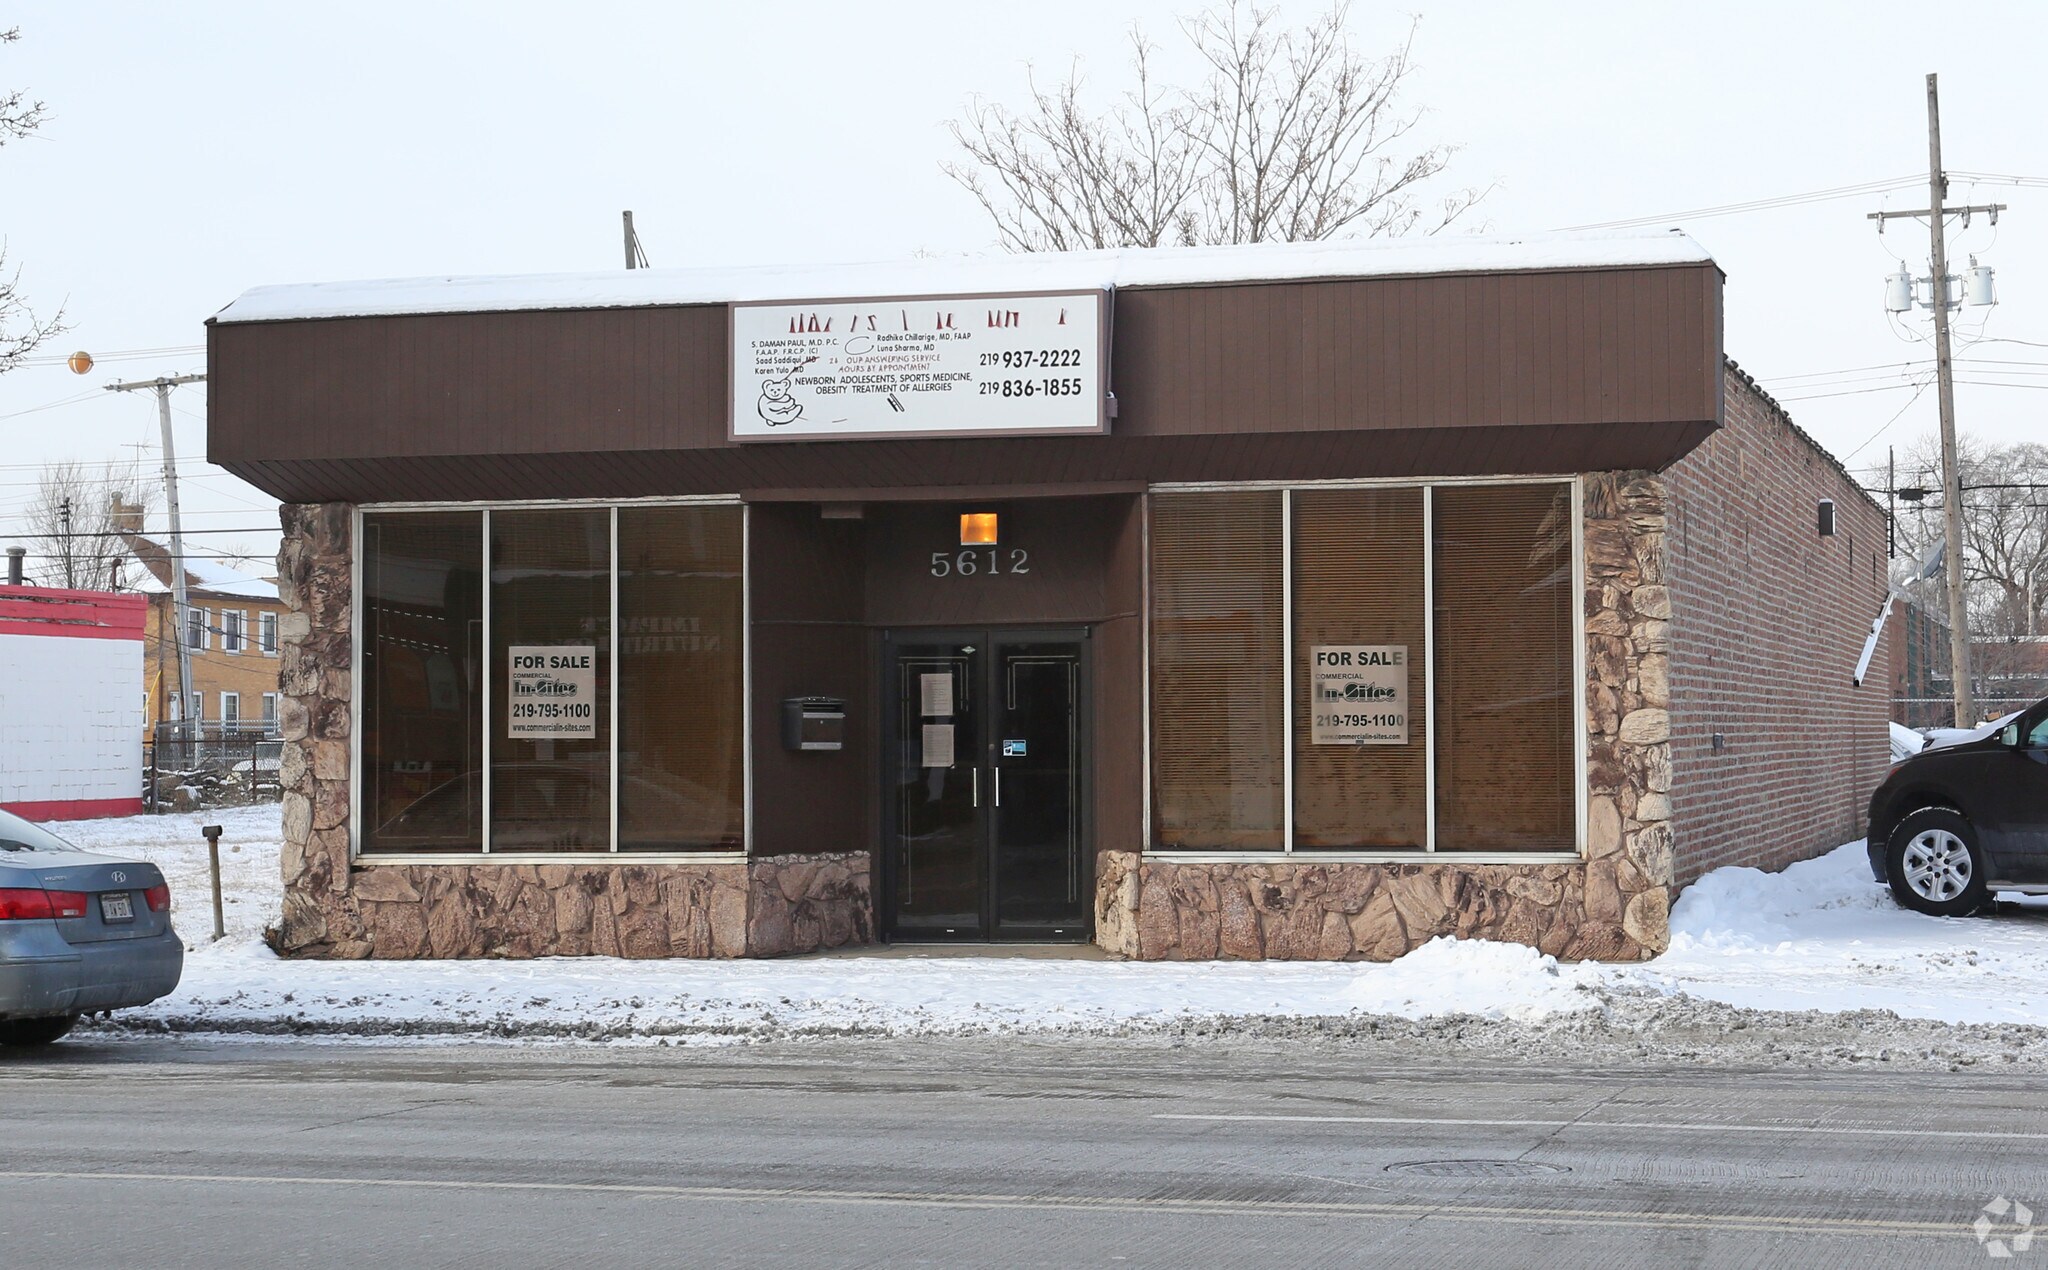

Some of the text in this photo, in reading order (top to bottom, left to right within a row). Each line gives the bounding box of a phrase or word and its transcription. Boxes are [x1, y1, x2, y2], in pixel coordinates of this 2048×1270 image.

[759, 340, 786, 348] DAMAN
[808, 338, 825, 347] M.D.
[826, 338, 840, 346] P.C.
[877, 332, 972, 343] Radhika Chillarige, MD, FAAP
[808, 347, 818, 355] (C)
[877, 343, 935, 353] Luna Sharma, MD
[755, 357, 772, 365] Saad
[911, 354, 941, 363] SERVICE
[979, 348, 1081, 369] 219 937-2222
[754, 367, 774, 375] Karen
[878, 363, 931, 372] APPOINTMENT
[795, 372, 973, 386] NEWBORN ADOLESCENTS, SPORTS MEDICINE,
[815, 383, 953, 395] OBESITY TREATMENT OF ALLERGIES
[979, 377, 1082, 398] 219 836-1855
[931, 548, 1030, 577] 5612
[513, 655, 590, 669] FOR SALE
[1317, 651, 1403, 667] FOR SALE
[513, 678, 578, 698] In-Sites
[1315, 680, 1397, 703] In-Sites
[513, 703, 591, 718] 219-795-1100
[1316, 714, 1404, 727] 219-795-1100
